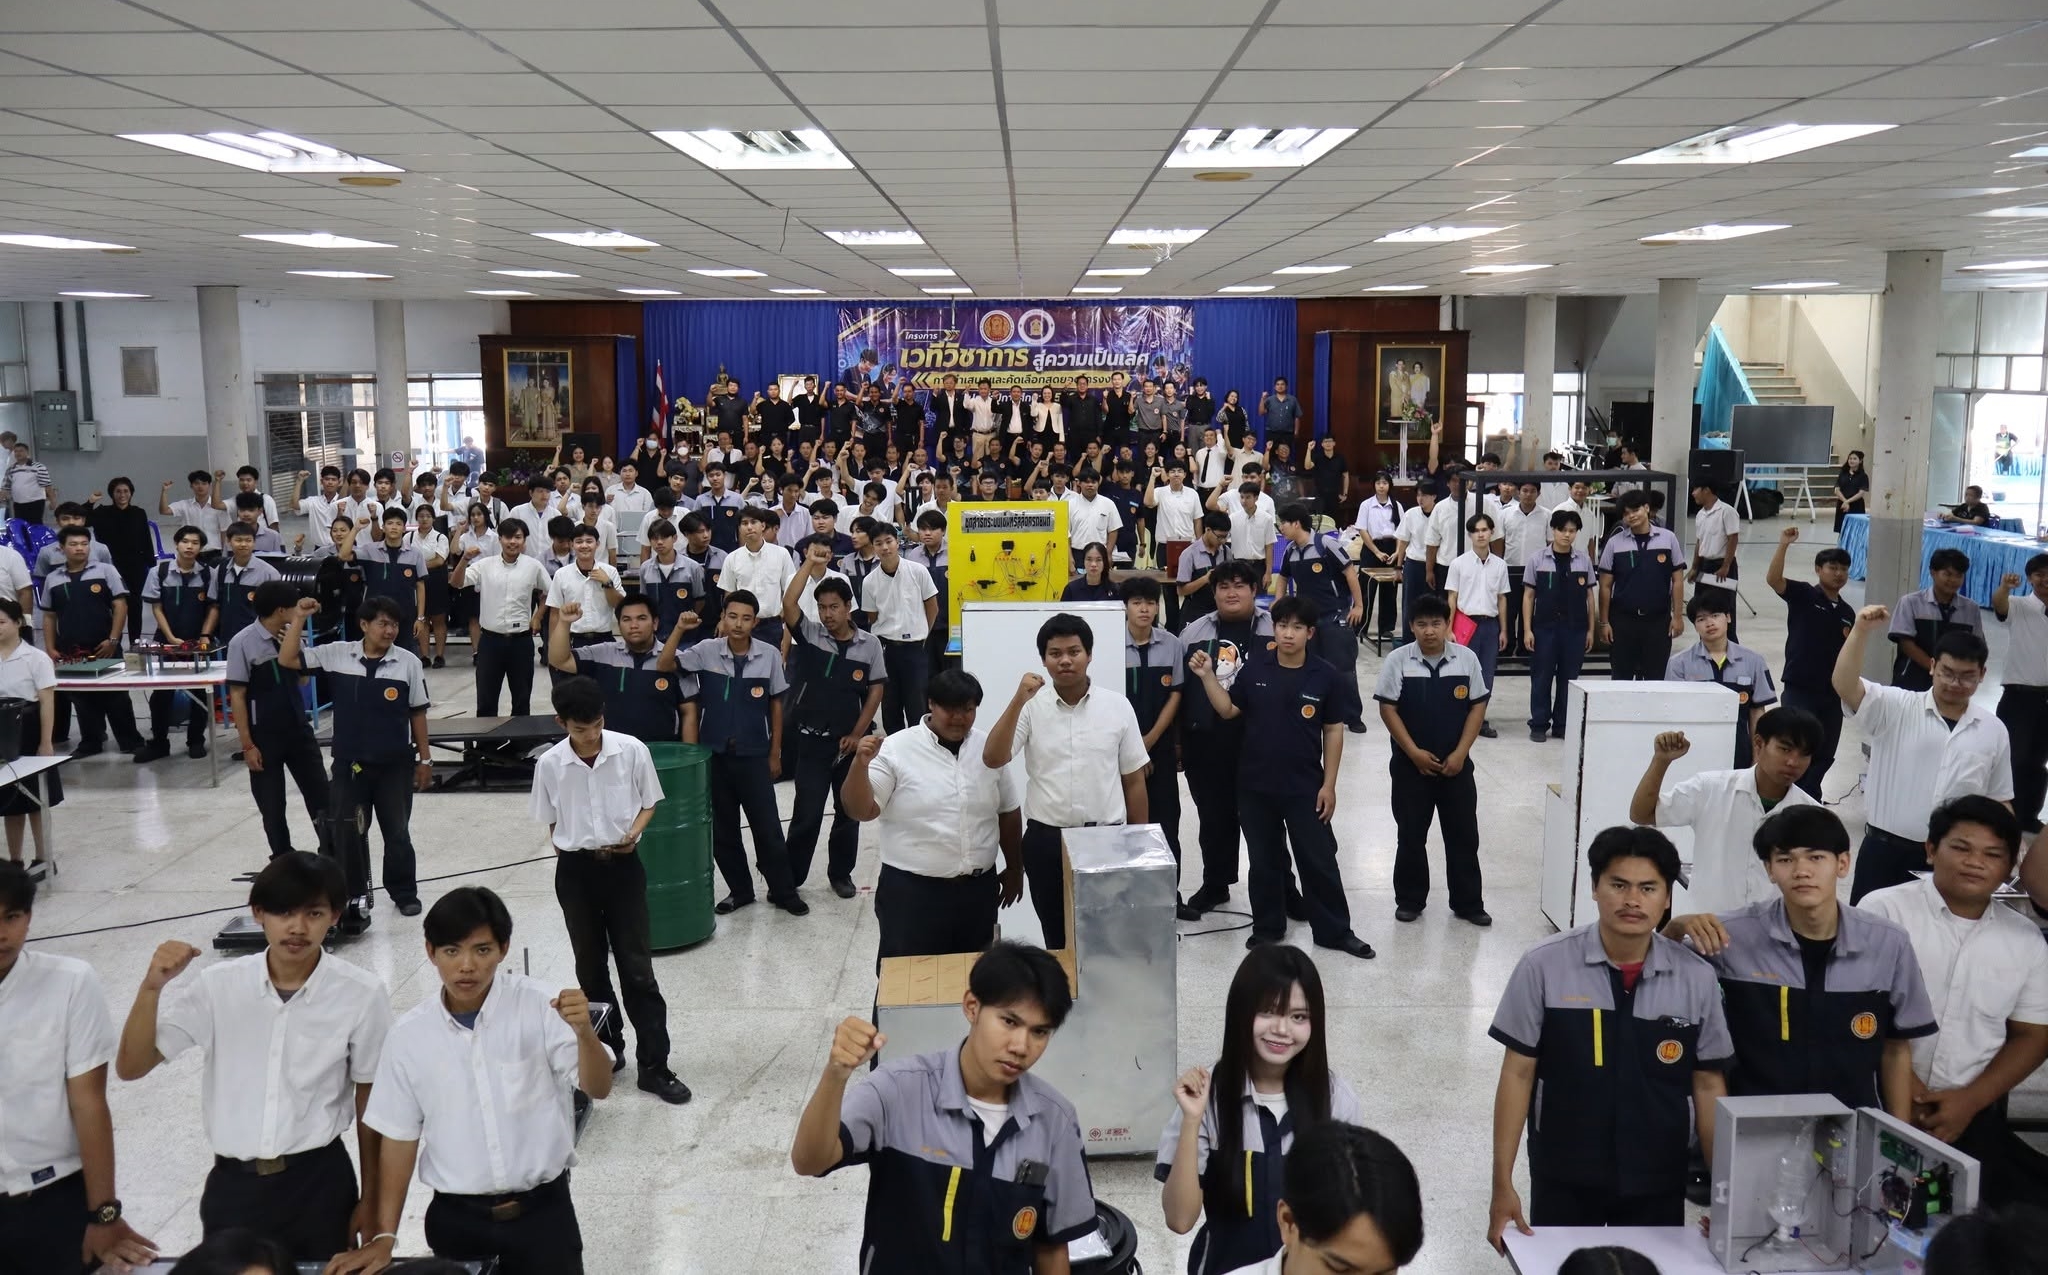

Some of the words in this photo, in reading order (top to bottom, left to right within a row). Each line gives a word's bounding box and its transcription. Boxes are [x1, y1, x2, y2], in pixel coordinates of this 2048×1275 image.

[905, 331, 938, 341] โครงการ
[900, 341, 1030, 368] เวทีวิชาการ
[1032, 347, 1150, 371] สู่ความเป็นเลิศ
